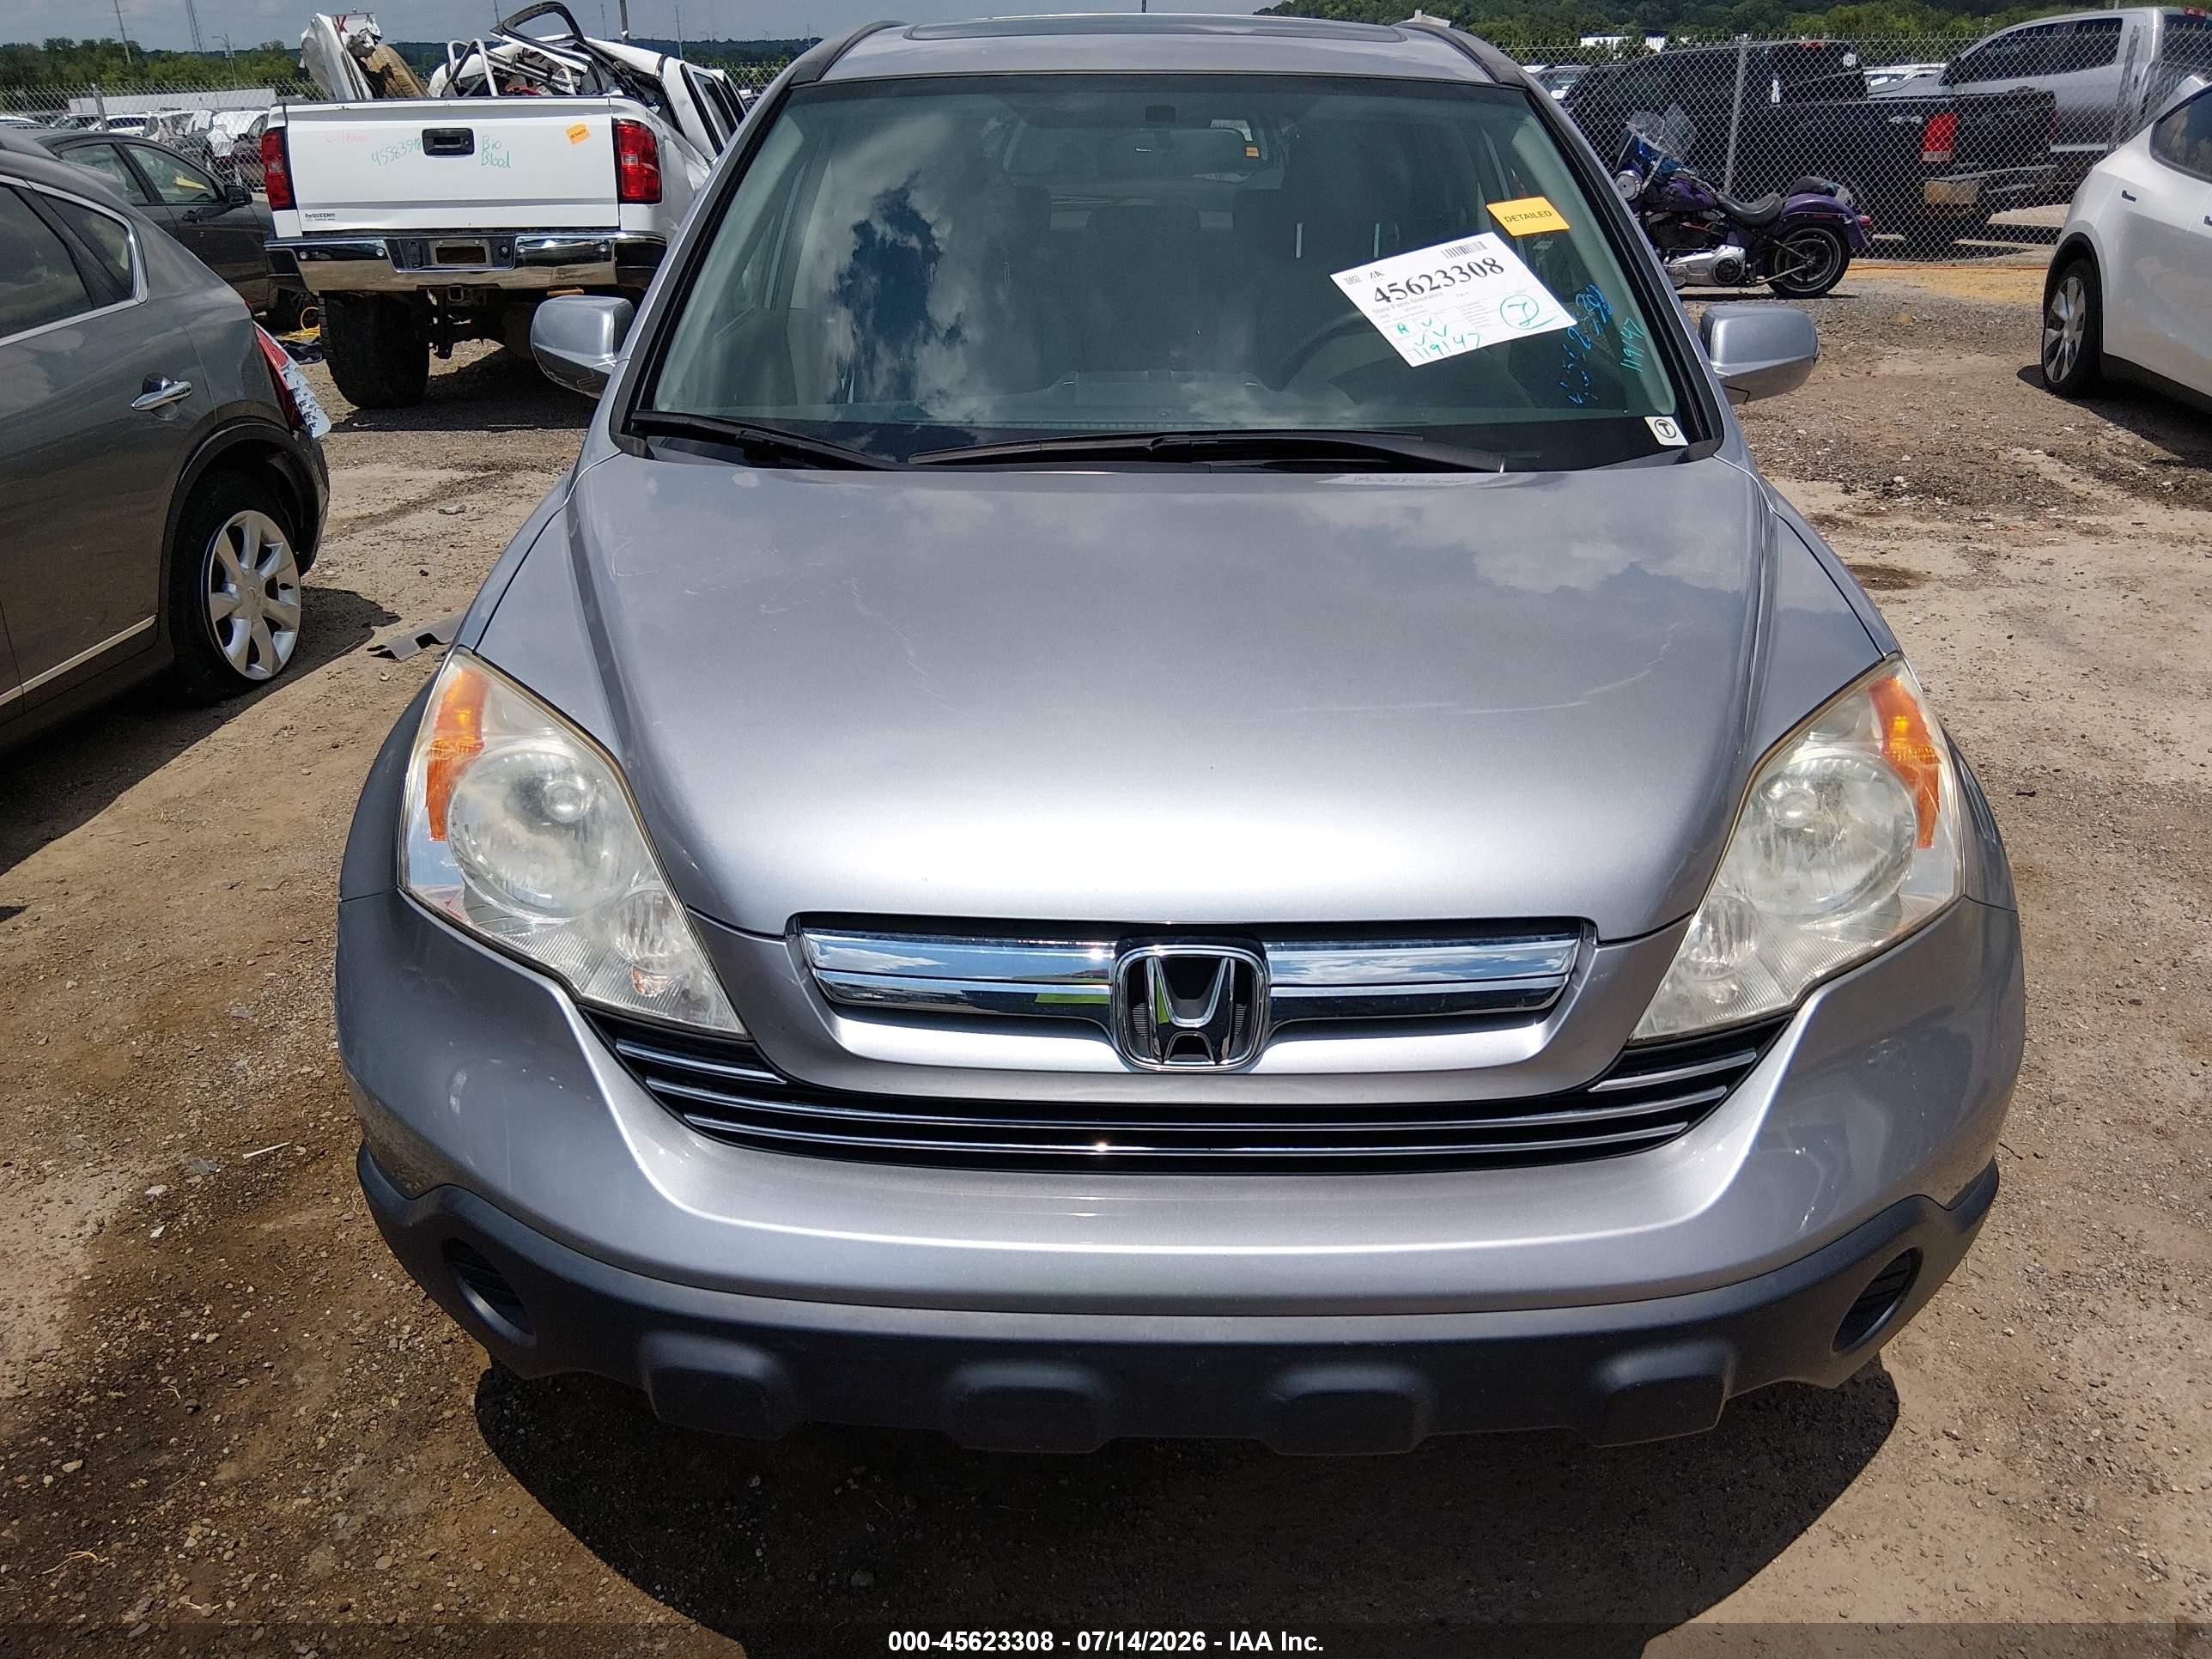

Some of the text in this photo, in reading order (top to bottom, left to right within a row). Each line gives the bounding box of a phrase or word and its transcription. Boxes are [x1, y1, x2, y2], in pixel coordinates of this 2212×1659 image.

[481, 135, 502, 151] Bio
[481, 150, 511, 168] Blood
[1504, 210, 1553, 223] DETAILED
[1375, 257, 1504, 303] 45623308
[1372, 306, 1390, 314] State
[1390, 301, 1411, 310] Farm
[1410, 292, 1443, 304] Insurance
